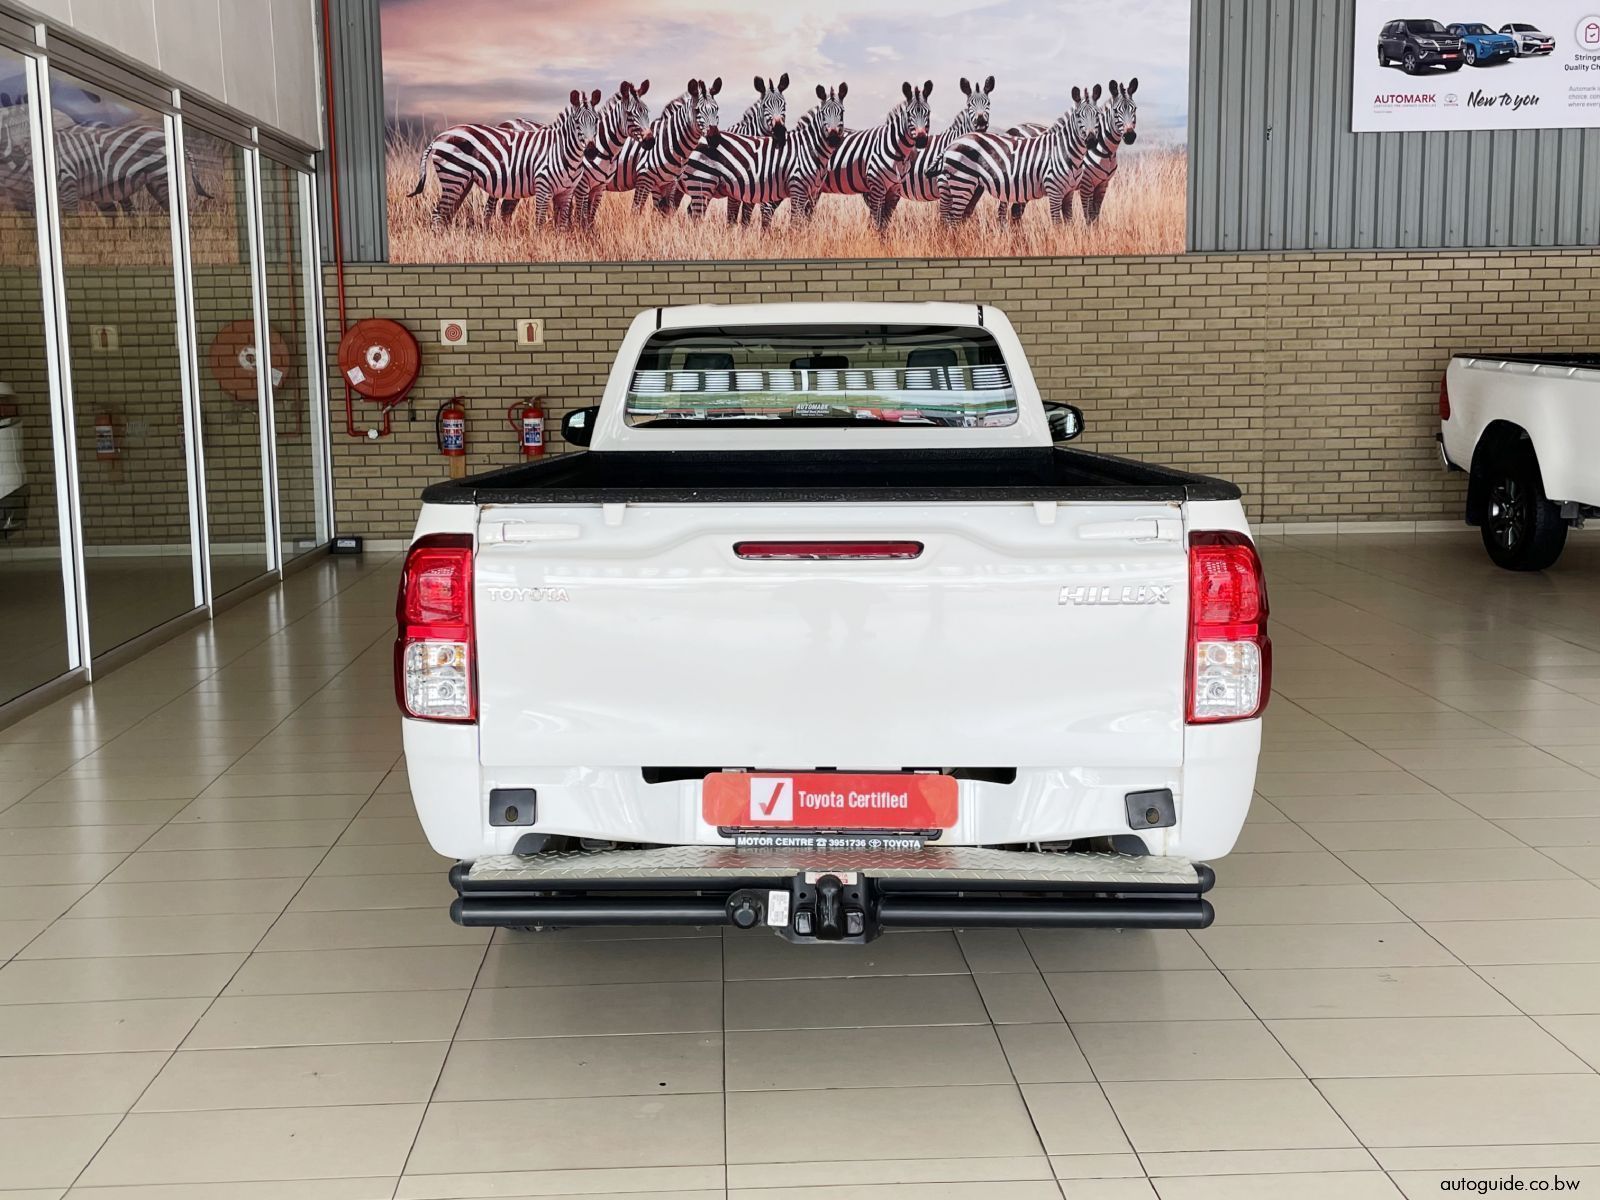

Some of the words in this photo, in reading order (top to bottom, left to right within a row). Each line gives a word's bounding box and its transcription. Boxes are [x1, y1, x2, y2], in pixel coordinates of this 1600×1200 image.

[1564, 63, 1590, 72] Quality
[1374, 94, 1436, 104] AUTOMARK
[1467, 89, 1497, 108] New
[1512, 94, 1540, 112] you
[487, 586, 570, 602] TOYOTA
[1058, 584, 1174, 605] HILUX
[798, 790, 844, 809] Toyota
[848, 790, 908, 808] Certified
[737, 837, 773, 847] MOTOR
[775, 837, 814, 847] CENTRE
[828, 838, 866, 848] 3951736
[883, 839, 921, 849] TOYOTA
